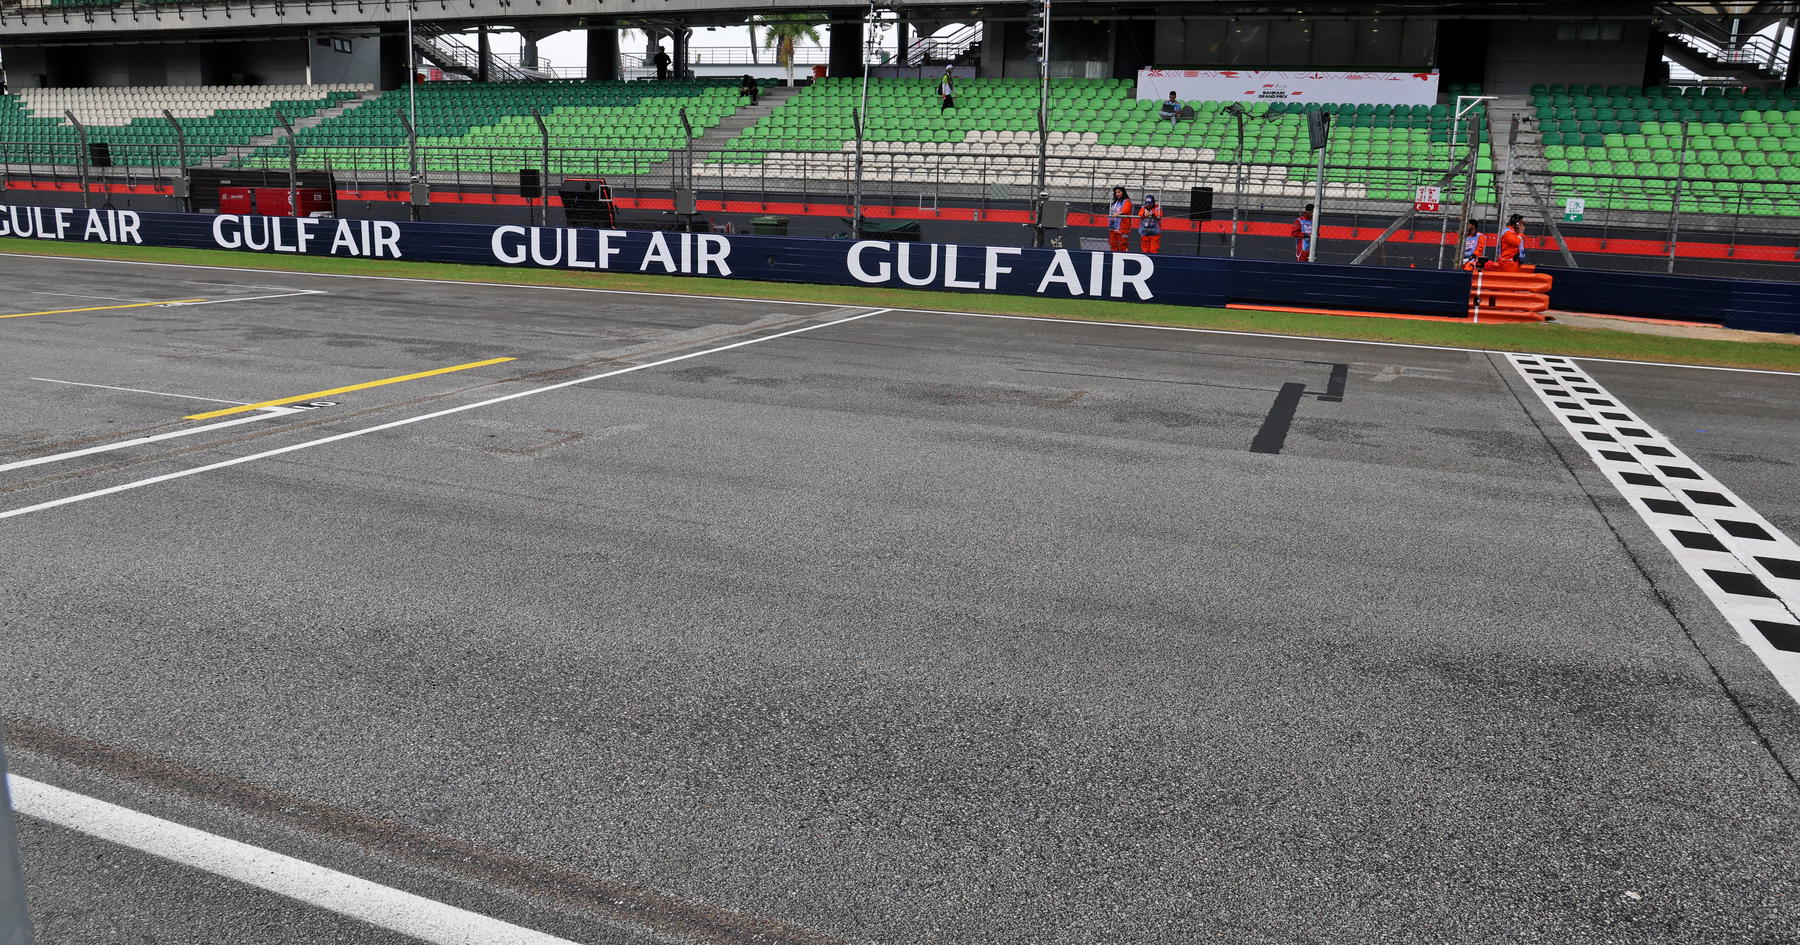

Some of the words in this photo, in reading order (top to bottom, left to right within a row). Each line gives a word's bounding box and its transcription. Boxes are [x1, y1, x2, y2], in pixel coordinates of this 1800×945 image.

[84, 208, 143, 244] AIR
[212, 214, 319, 253] GULF
[330, 218, 402, 259] AIR
[491, 225, 627, 270] GULF
[639, 230, 732, 278] AIR
[846, 240, 1022, 290] GULF
[1036, 248, 1154, 301] AIR
